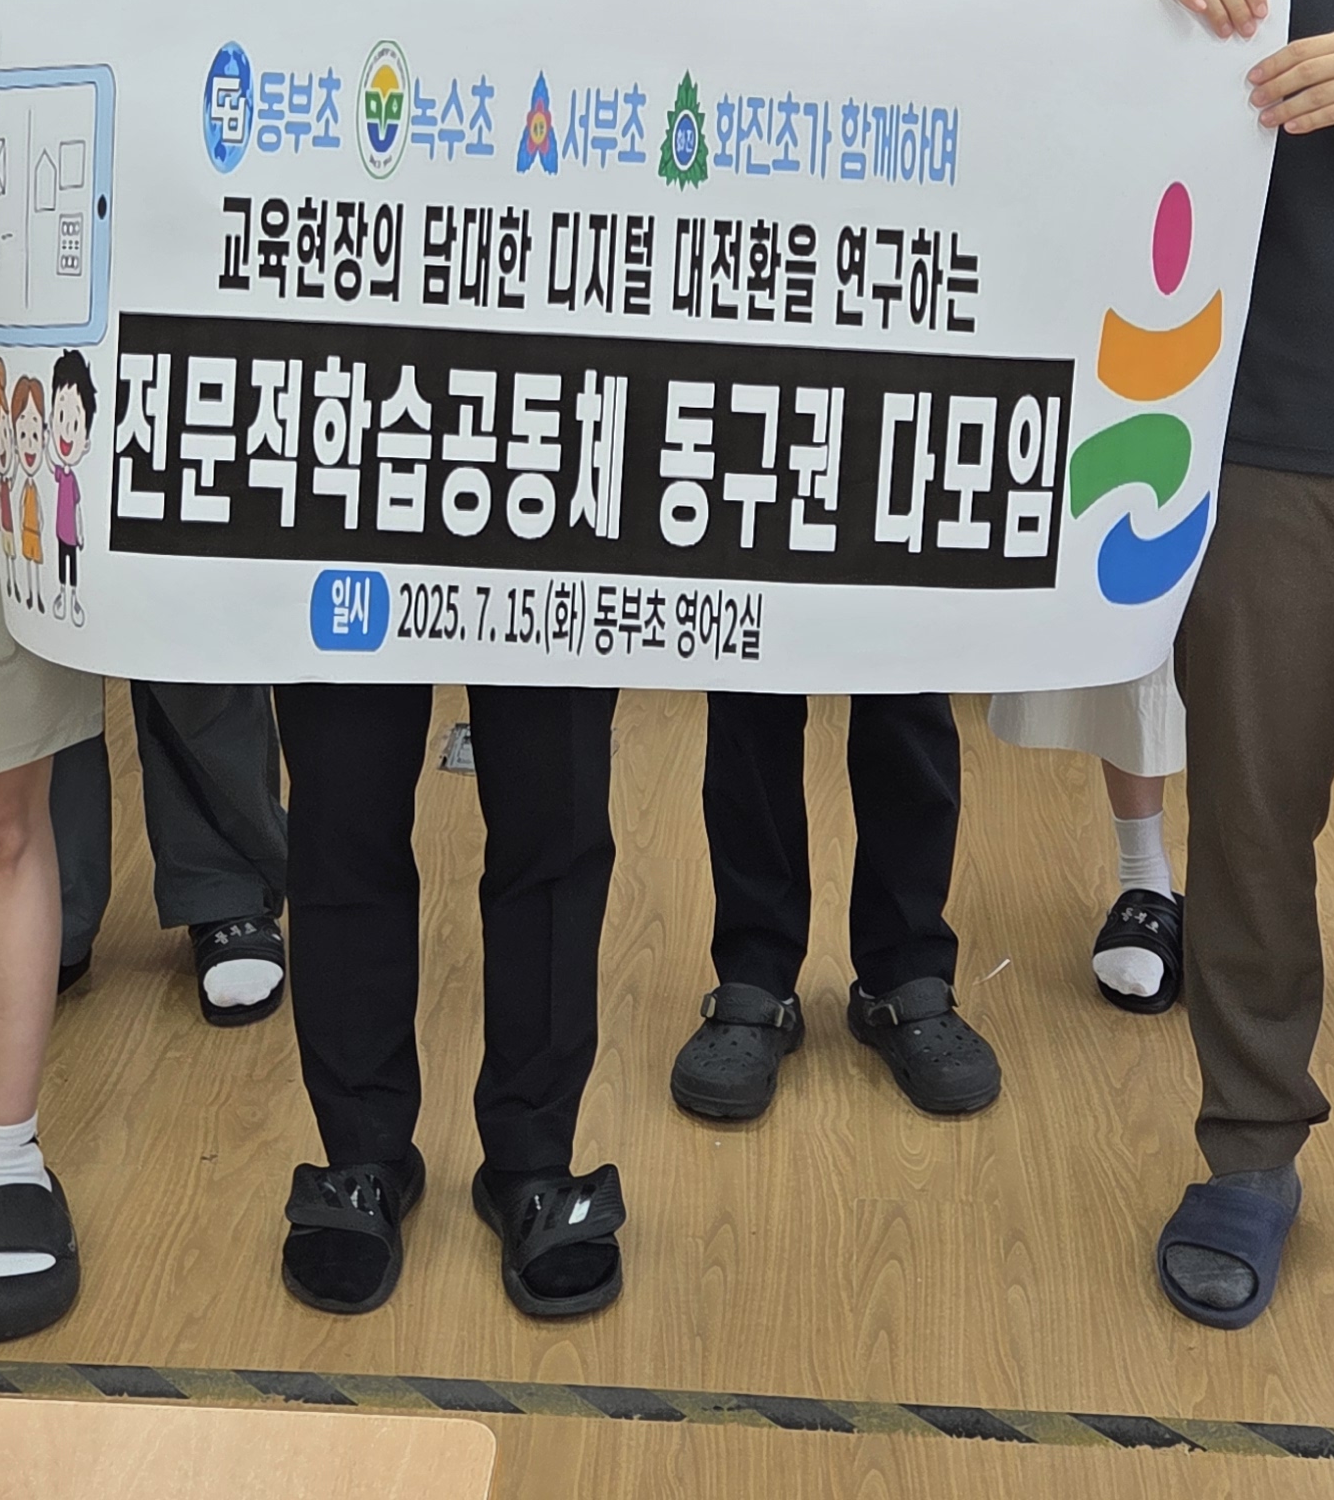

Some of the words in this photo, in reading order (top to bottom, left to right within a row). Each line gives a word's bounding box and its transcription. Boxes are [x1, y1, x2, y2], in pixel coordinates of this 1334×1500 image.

[257, 67, 341, 154] 동부초
[411, 74, 495, 163] 녹수초
[562, 82, 647, 170] 서부초
[713, 91, 832, 181] 화진초가
[840, 97, 959, 187] 함께하며
[218, 196, 404, 302] 교육현장의
[422, 205, 532, 309] 담대한
[547, 211, 655, 315] 디지털
[672, 217, 817, 324] 대전환을
[835, 225, 979, 333] 연구하는
[115, 353, 629, 540] 전문적학습공동체
[659, 380, 845, 553] 동구권
[874, 392, 1061, 559] 다모임
[330, 576, 371, 636] 일시
[397, 583, 467, 642] 2025.
[475, 586, 497, 644] 7.
[592, 585, 666, 656] 동부초
[675, 589, 763, 662] 영어2실
